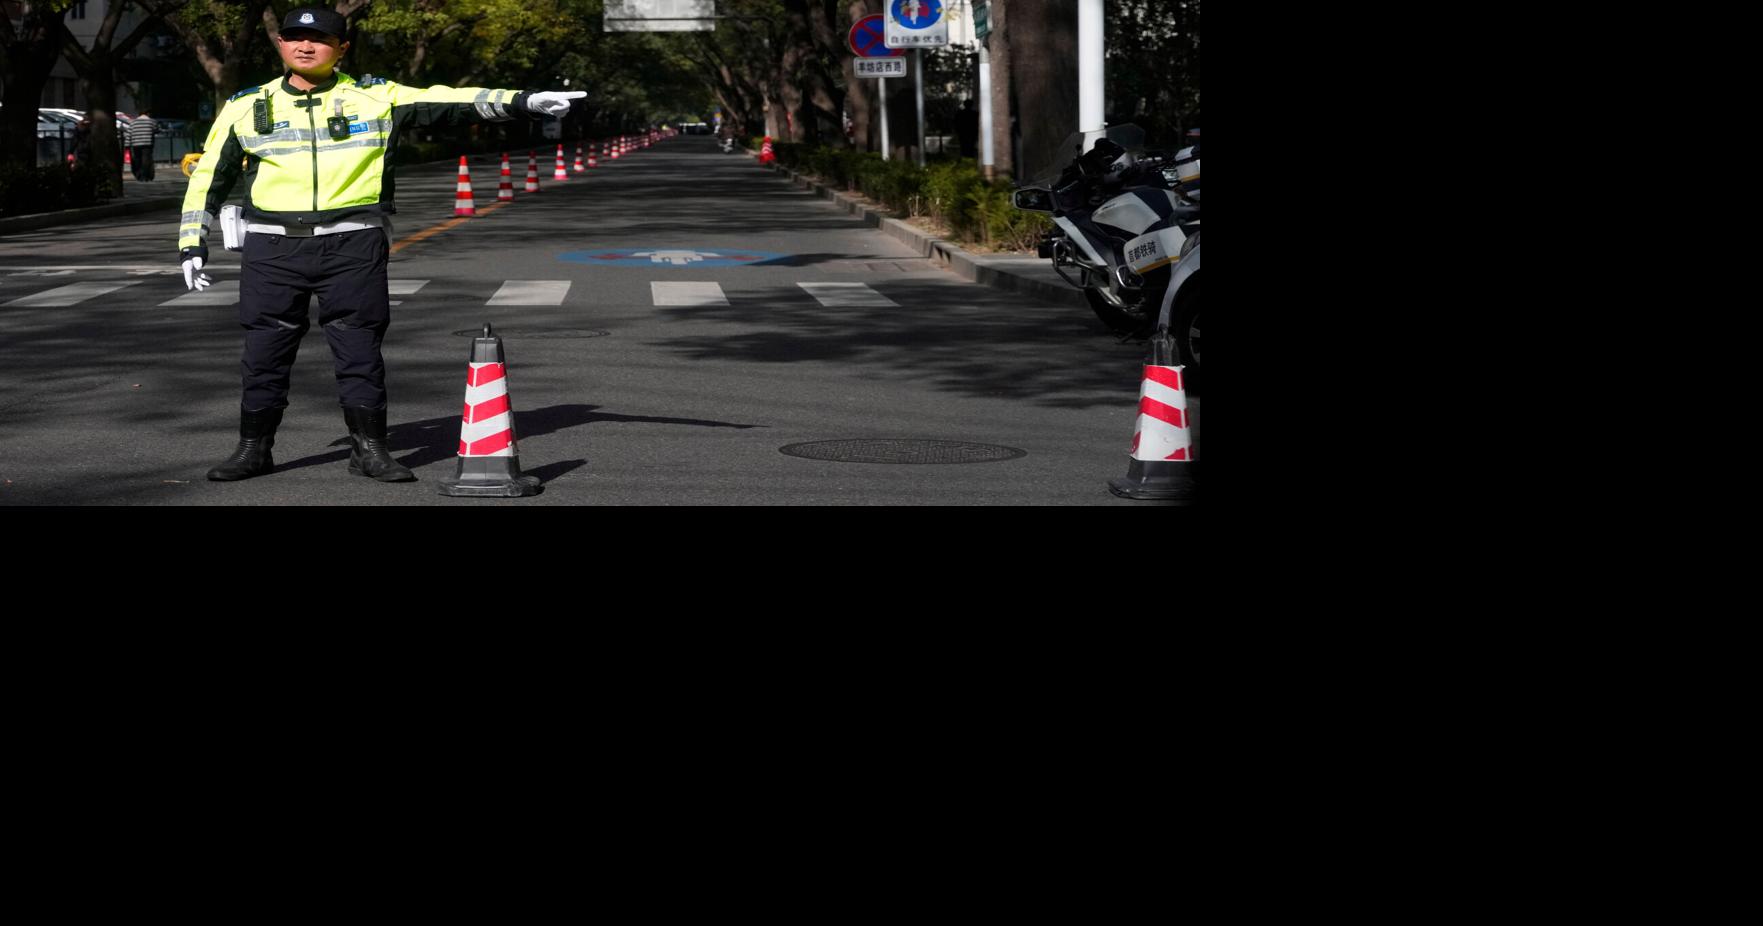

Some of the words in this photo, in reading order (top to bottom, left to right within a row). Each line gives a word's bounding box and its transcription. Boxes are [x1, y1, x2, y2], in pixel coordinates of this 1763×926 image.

[891, 35, 944, 43] 自行车优先
[1128, 241, 1157, 262] 首都铁骑
